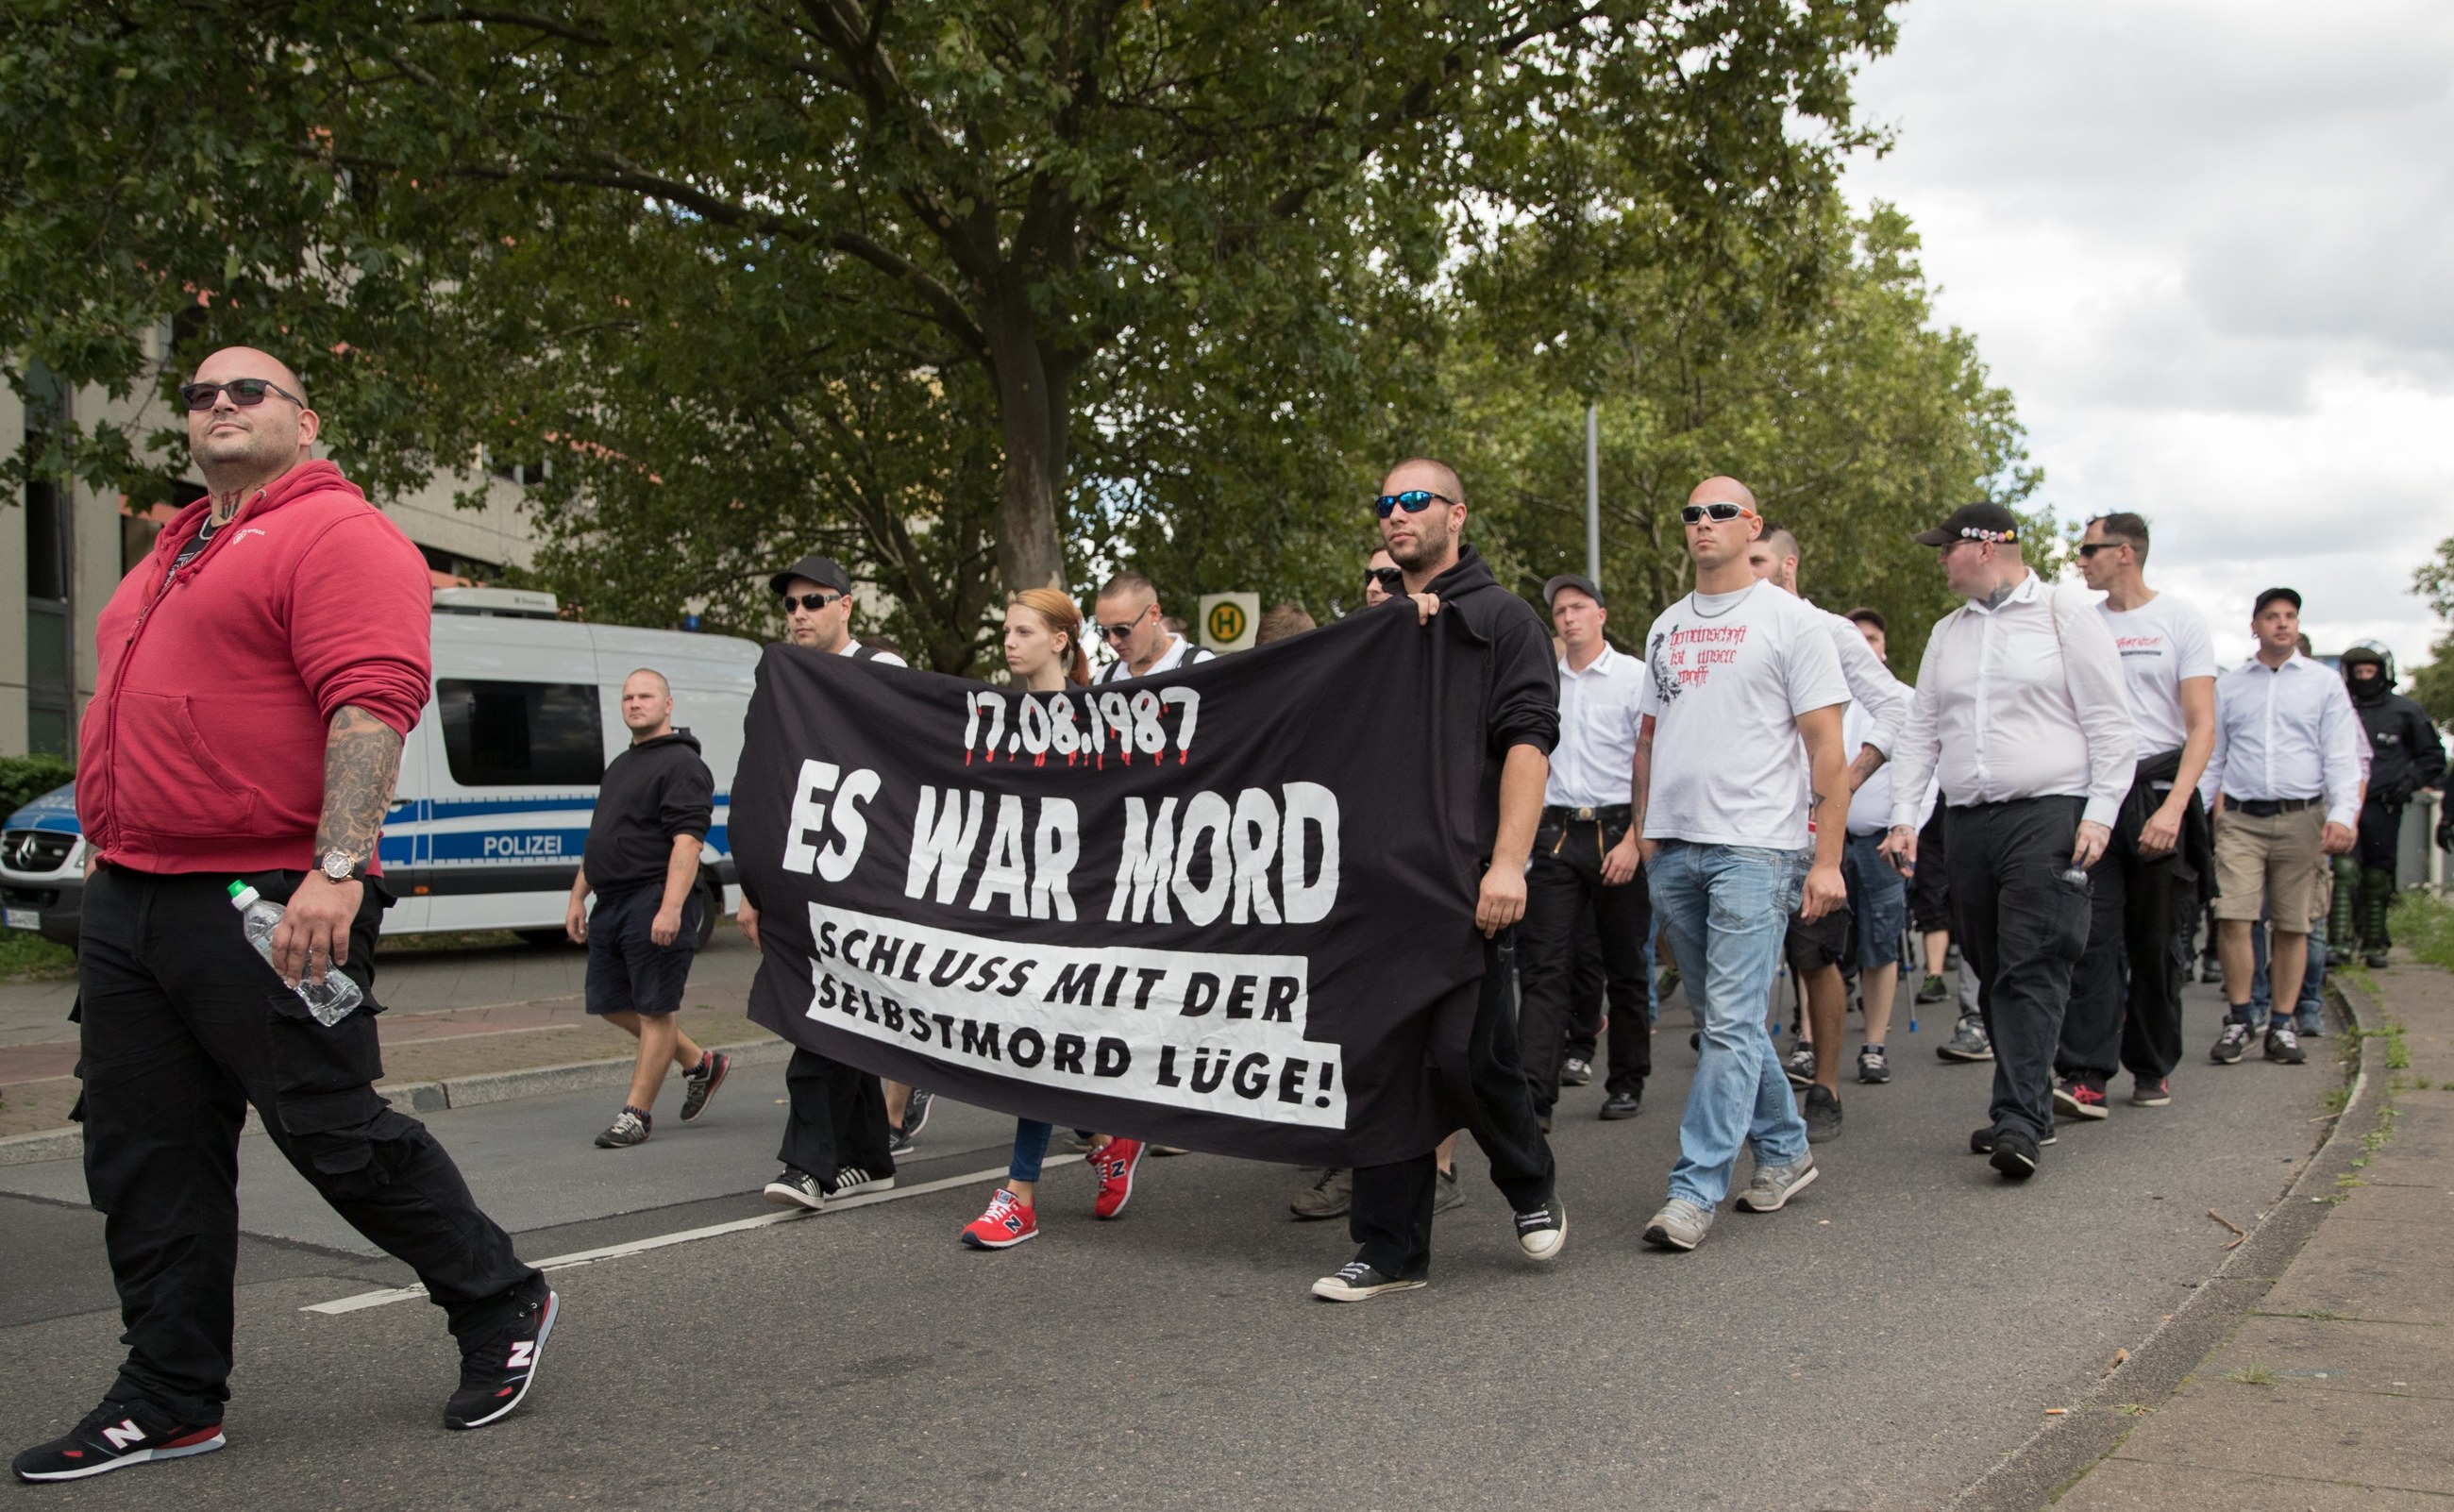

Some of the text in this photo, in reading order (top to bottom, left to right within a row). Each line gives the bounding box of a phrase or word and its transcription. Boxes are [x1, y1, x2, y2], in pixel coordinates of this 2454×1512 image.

[1218, 612, 1235, 634] H
[965, 686, 1202, 761] 17.08.1987
[483, 834, 563, 856] POLIZEI
[782, 759, 1340, 927] ES WAR MORD
[820, 921, 1301, 1023] SCHLUSS MIT DER
[818, 973, 1335, 1109] SELBSTMORD LÜGE!
[102, 1419, 146, 1450] N
